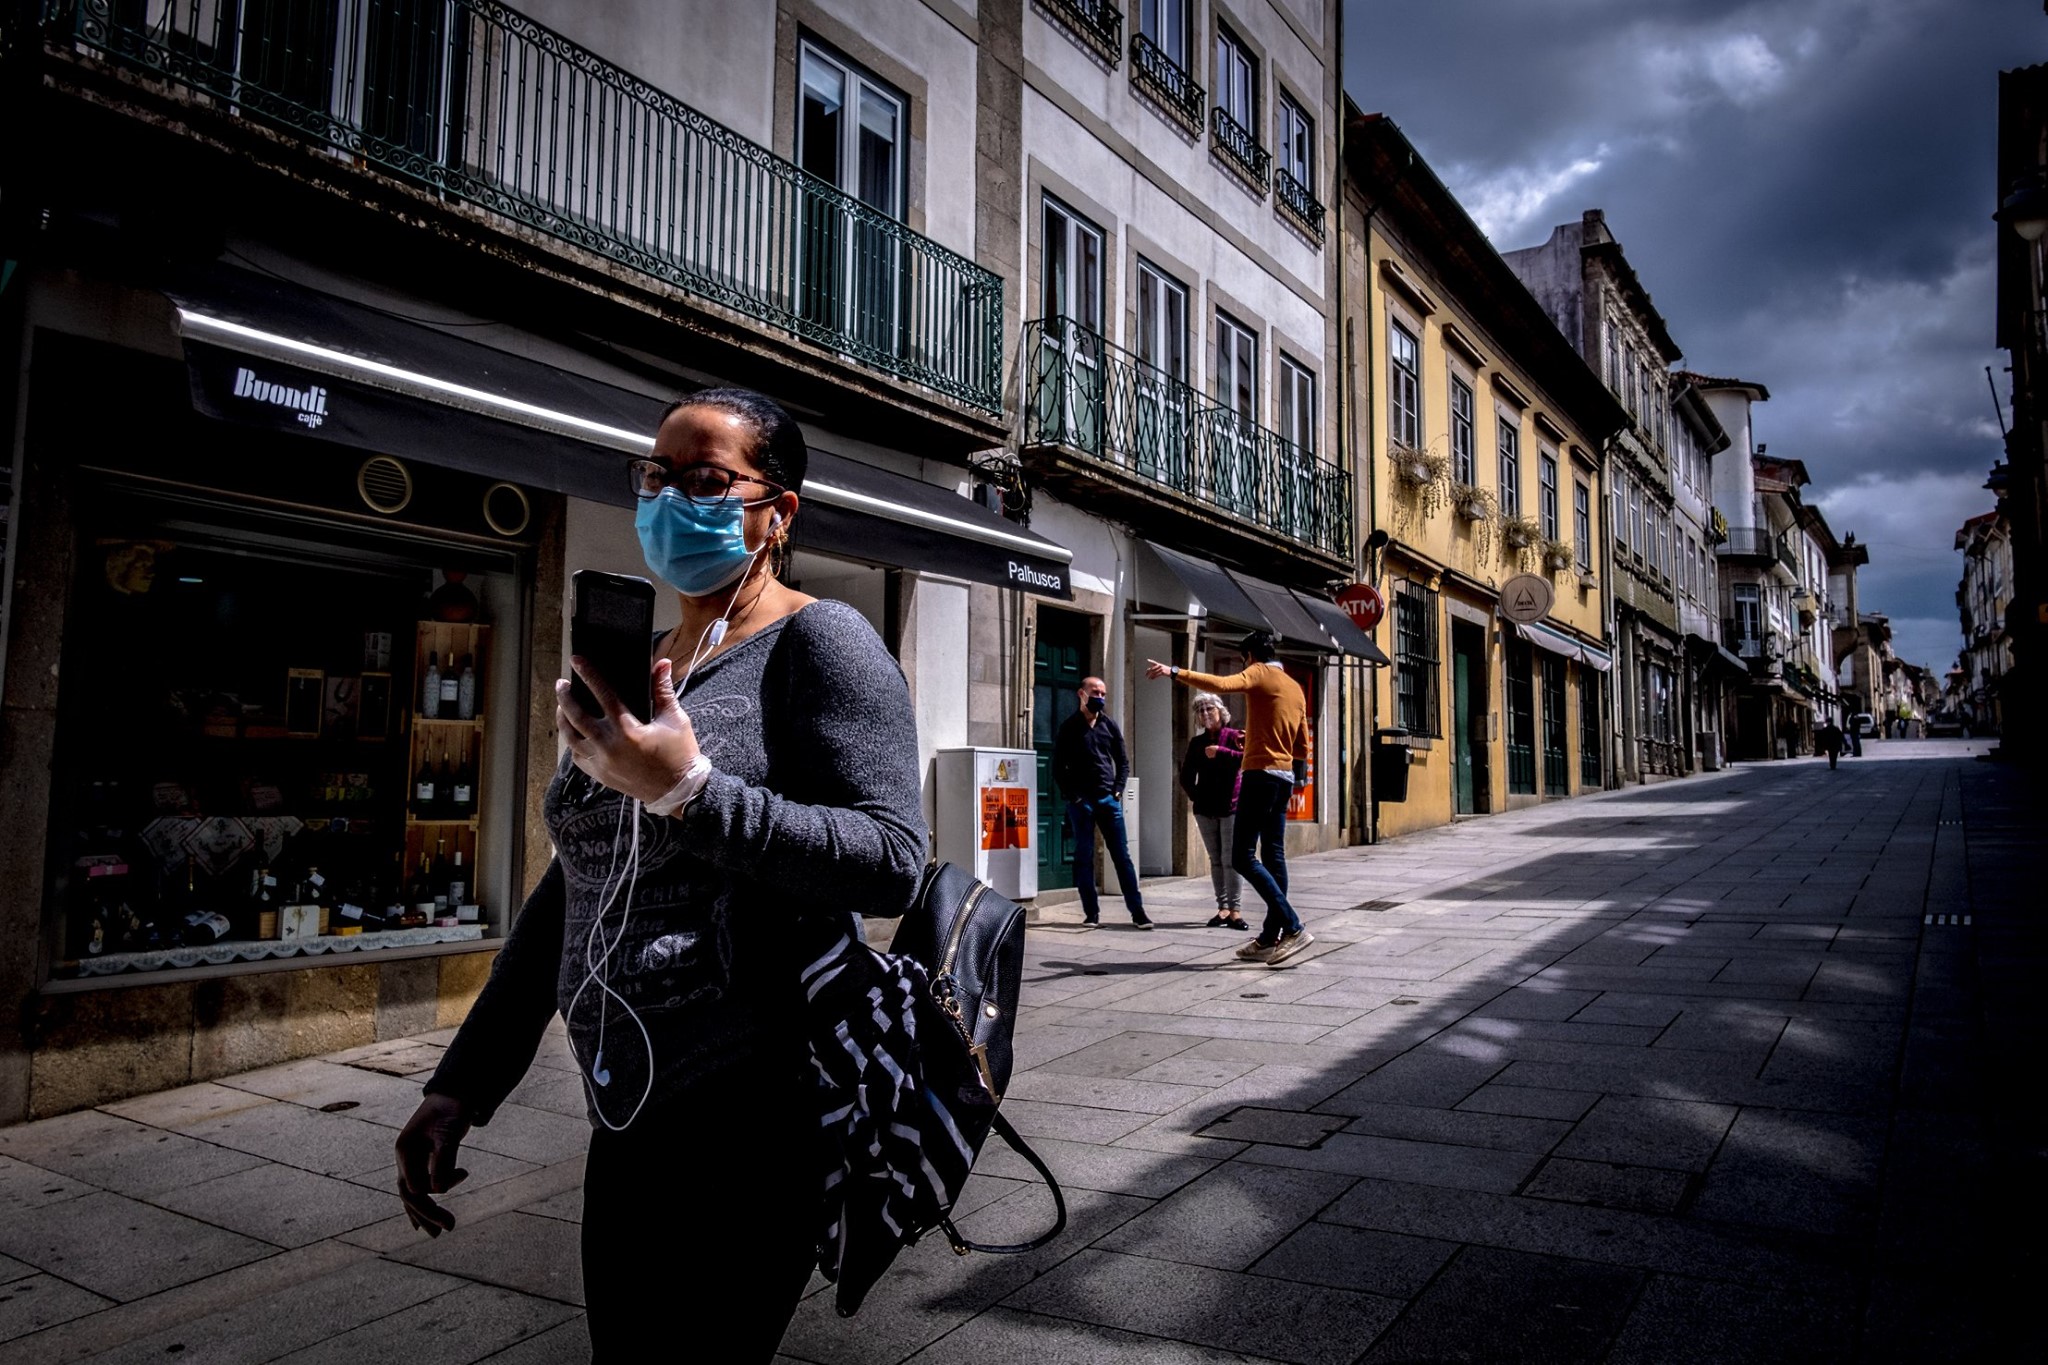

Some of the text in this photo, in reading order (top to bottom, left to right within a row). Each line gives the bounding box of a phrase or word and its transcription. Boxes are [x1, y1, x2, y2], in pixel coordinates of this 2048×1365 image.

[1008, 560, 1062, 590] Palhusca
[1341, 598, 1376, 616] ATM
[1287, 794, 1306, 813] ATM
[568, 808, 641, 837] NAUGHT
